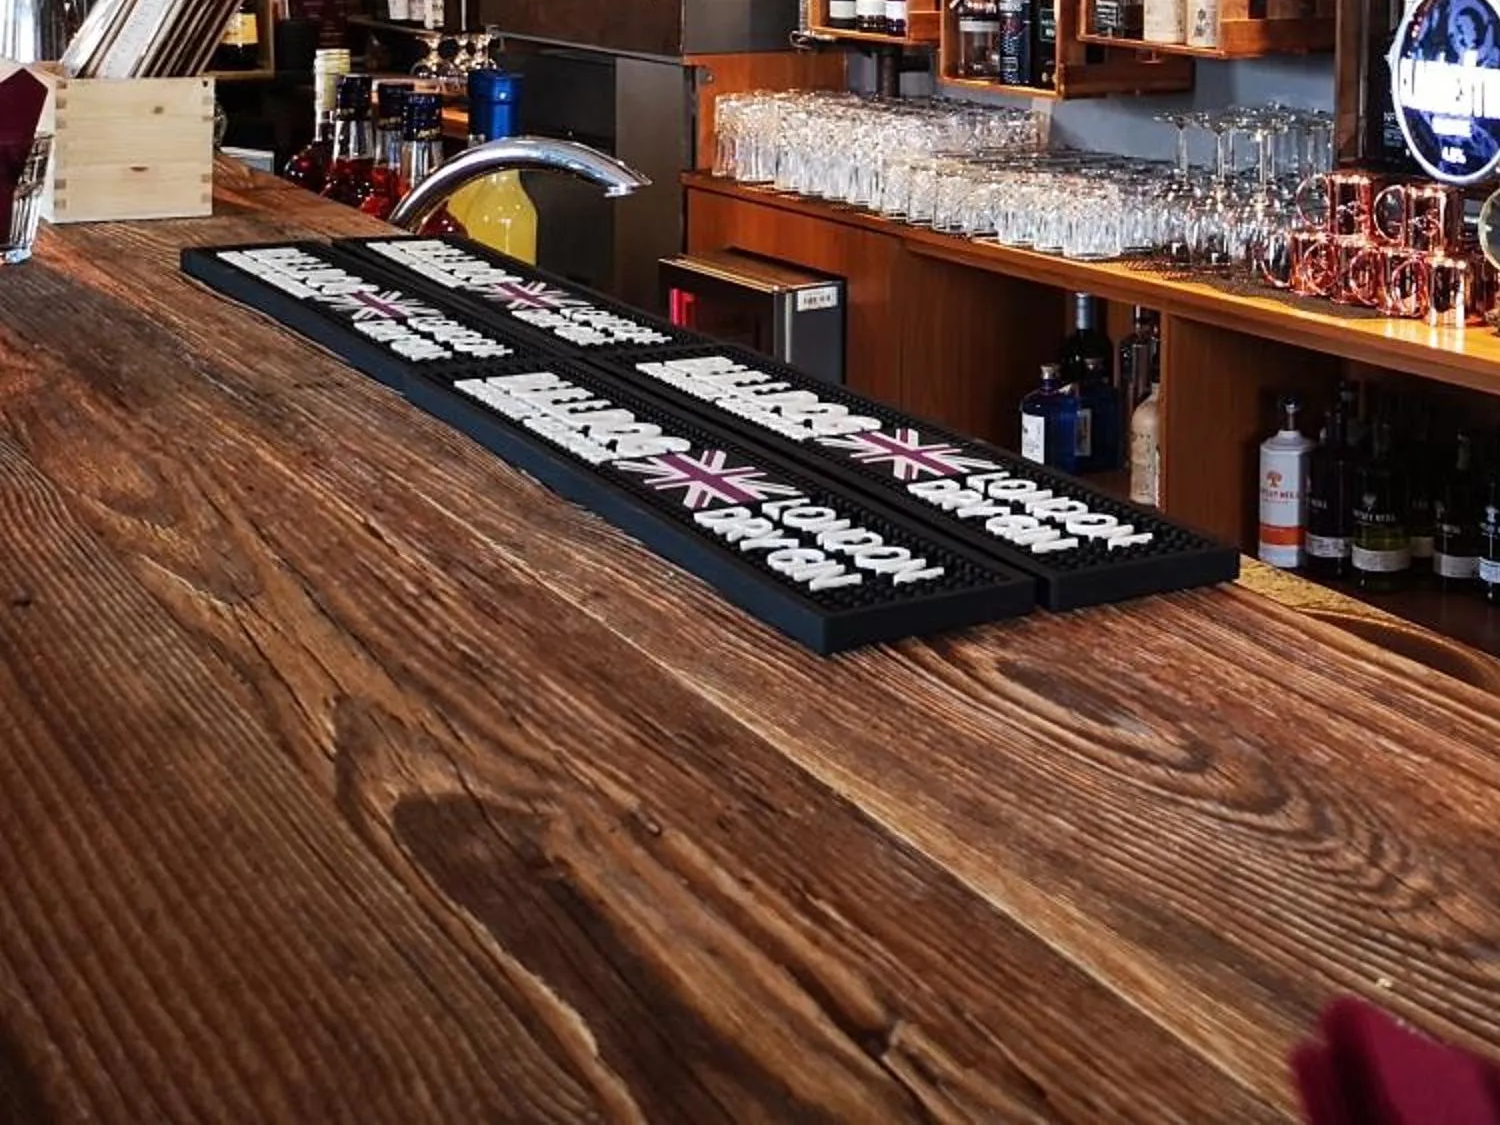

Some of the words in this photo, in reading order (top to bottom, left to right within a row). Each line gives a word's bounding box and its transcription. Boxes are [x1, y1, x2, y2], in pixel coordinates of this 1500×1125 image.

[694, 506, 799, 552] DRY
[767, 548, 862, 592] GIN
[762, 497, 945, 586] LONDON
[907, 478, 1010, 518] DRY
[985, 514, 1079, 555] GIN
[966, 471, 1153, 551] LONDON
